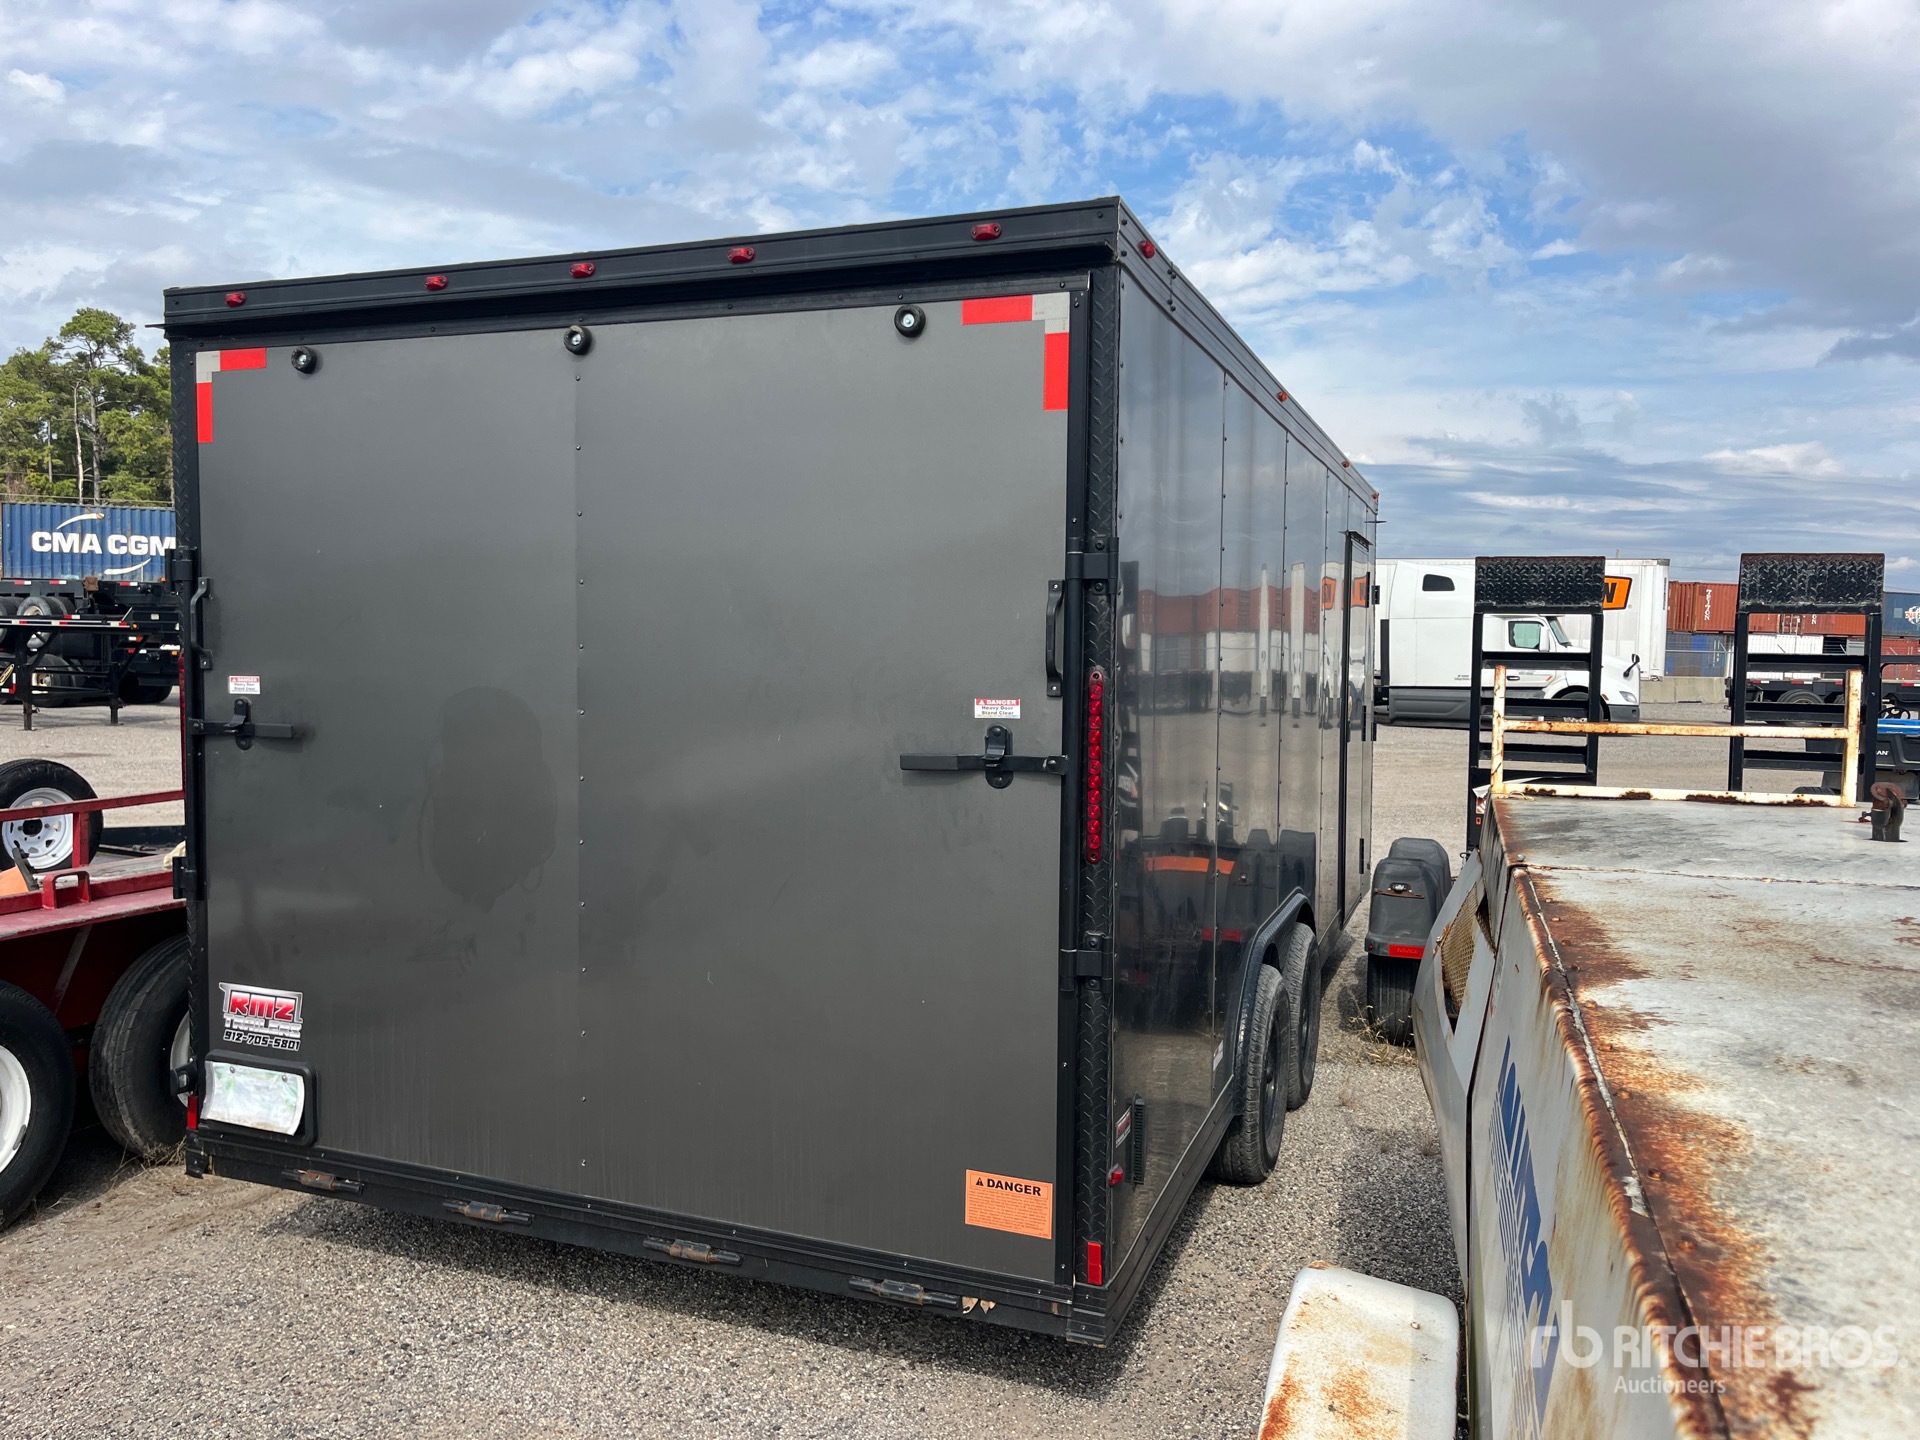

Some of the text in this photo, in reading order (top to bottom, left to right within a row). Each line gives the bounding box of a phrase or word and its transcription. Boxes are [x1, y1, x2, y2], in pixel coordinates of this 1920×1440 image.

[31, 531, 176, 556] CMA CGM
[223, 1013, 302, 1038] TRAILERS
[224, 1030, 300, 1051] 912-705-5801
[987, 1178, 1041, 1196] DANGER
